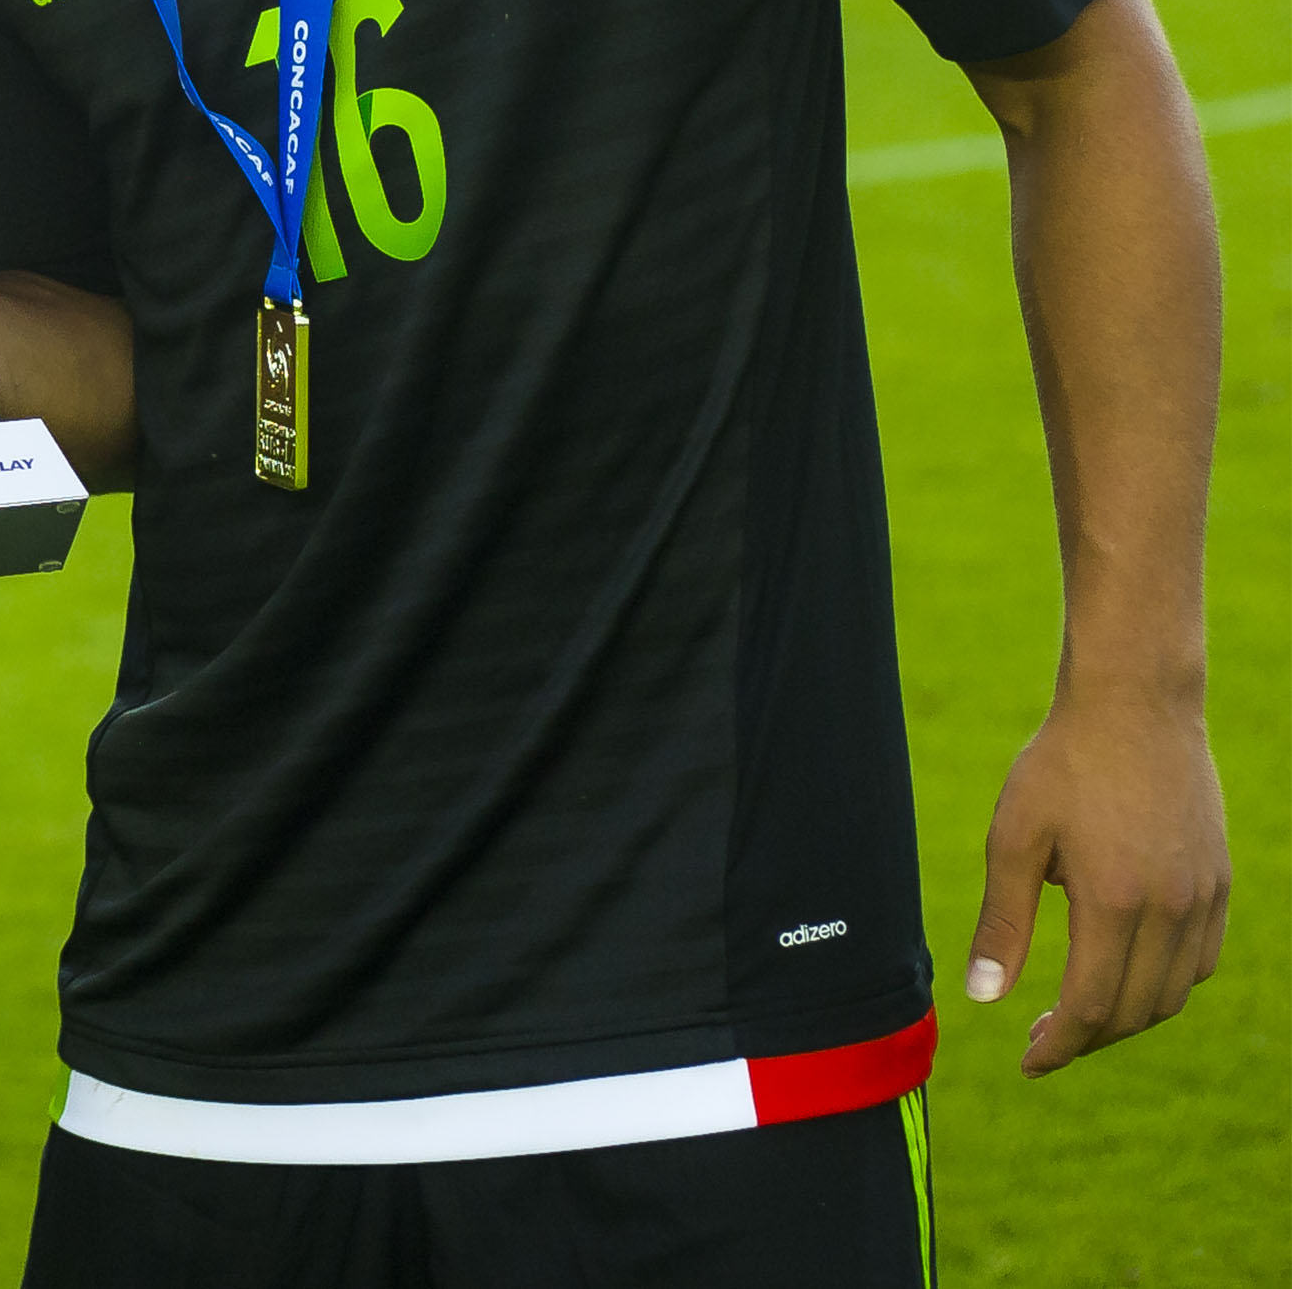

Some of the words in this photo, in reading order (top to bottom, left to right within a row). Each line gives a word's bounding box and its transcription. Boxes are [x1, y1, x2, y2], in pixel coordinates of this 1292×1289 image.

[283, 19, 310, 195] CONCACAF
[209, 114, 274, 187] ACAF
[779, 919, 848, 948] adizero
